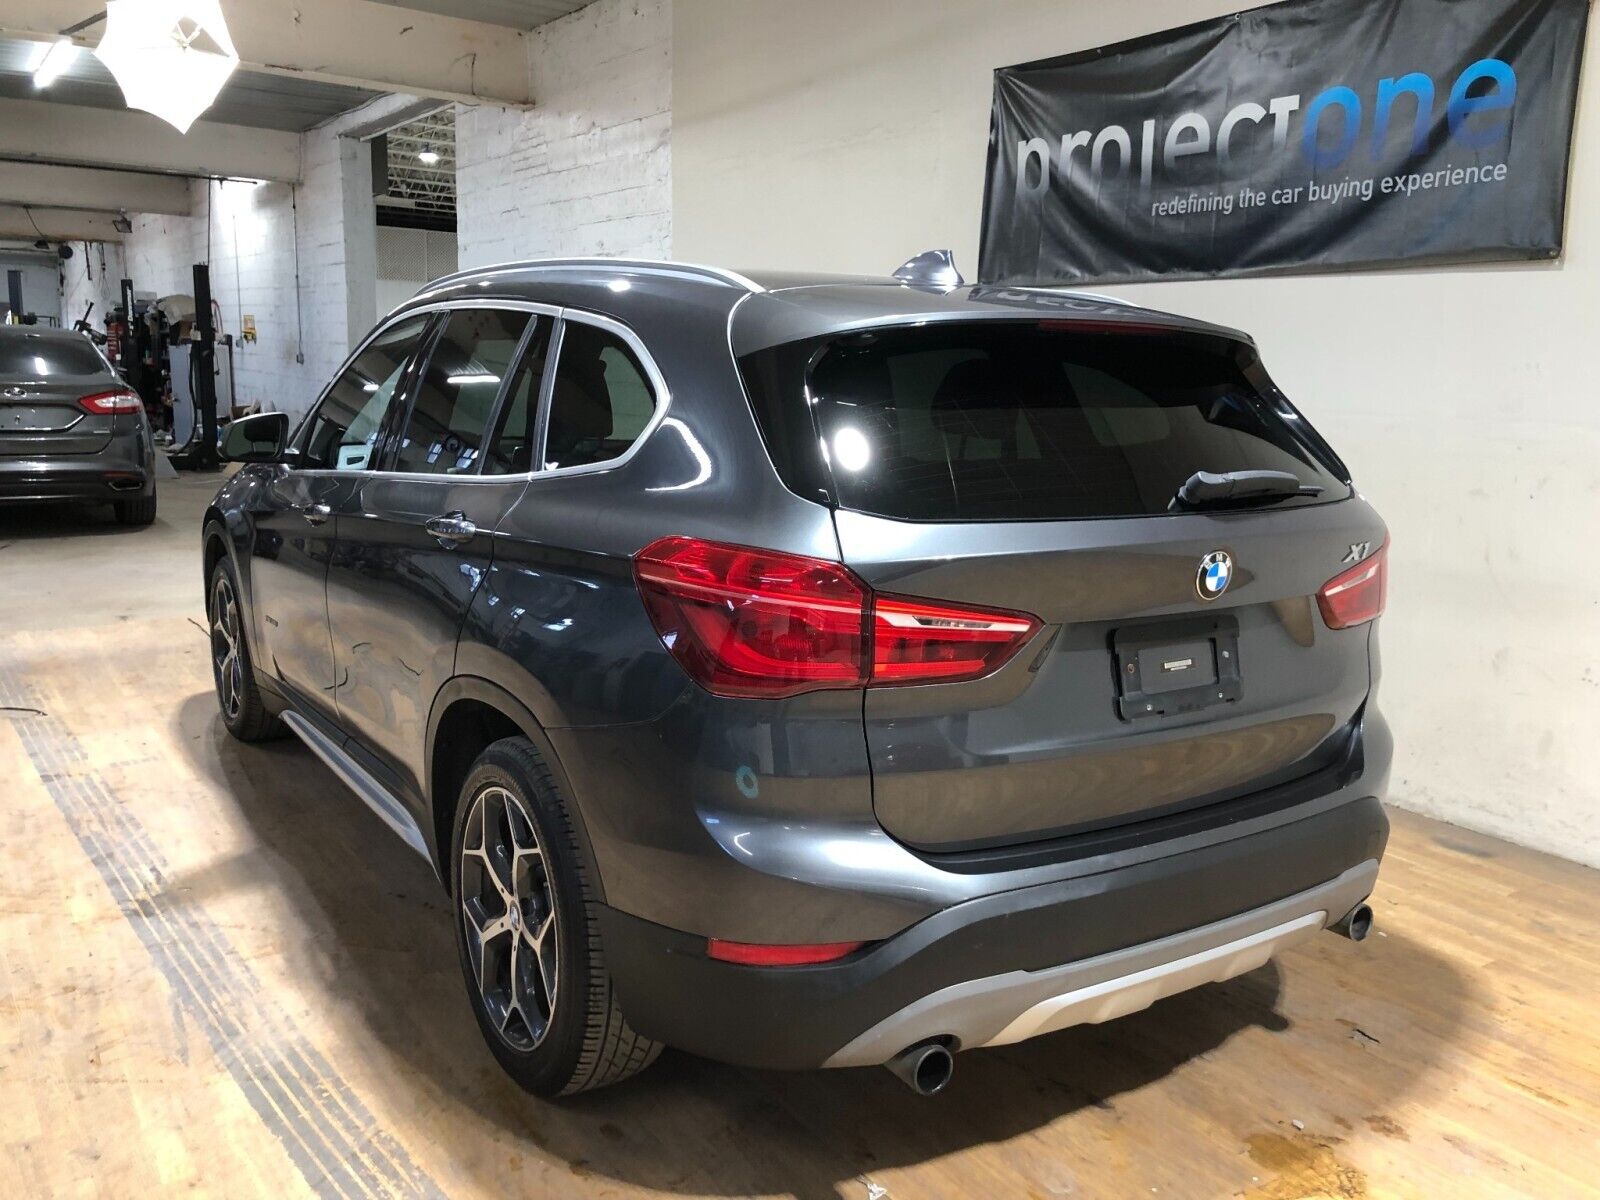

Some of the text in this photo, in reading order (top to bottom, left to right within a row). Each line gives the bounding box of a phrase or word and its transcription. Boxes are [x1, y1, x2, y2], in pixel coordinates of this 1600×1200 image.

[1151, 163, 1508, 217] redefining the car buying experience
